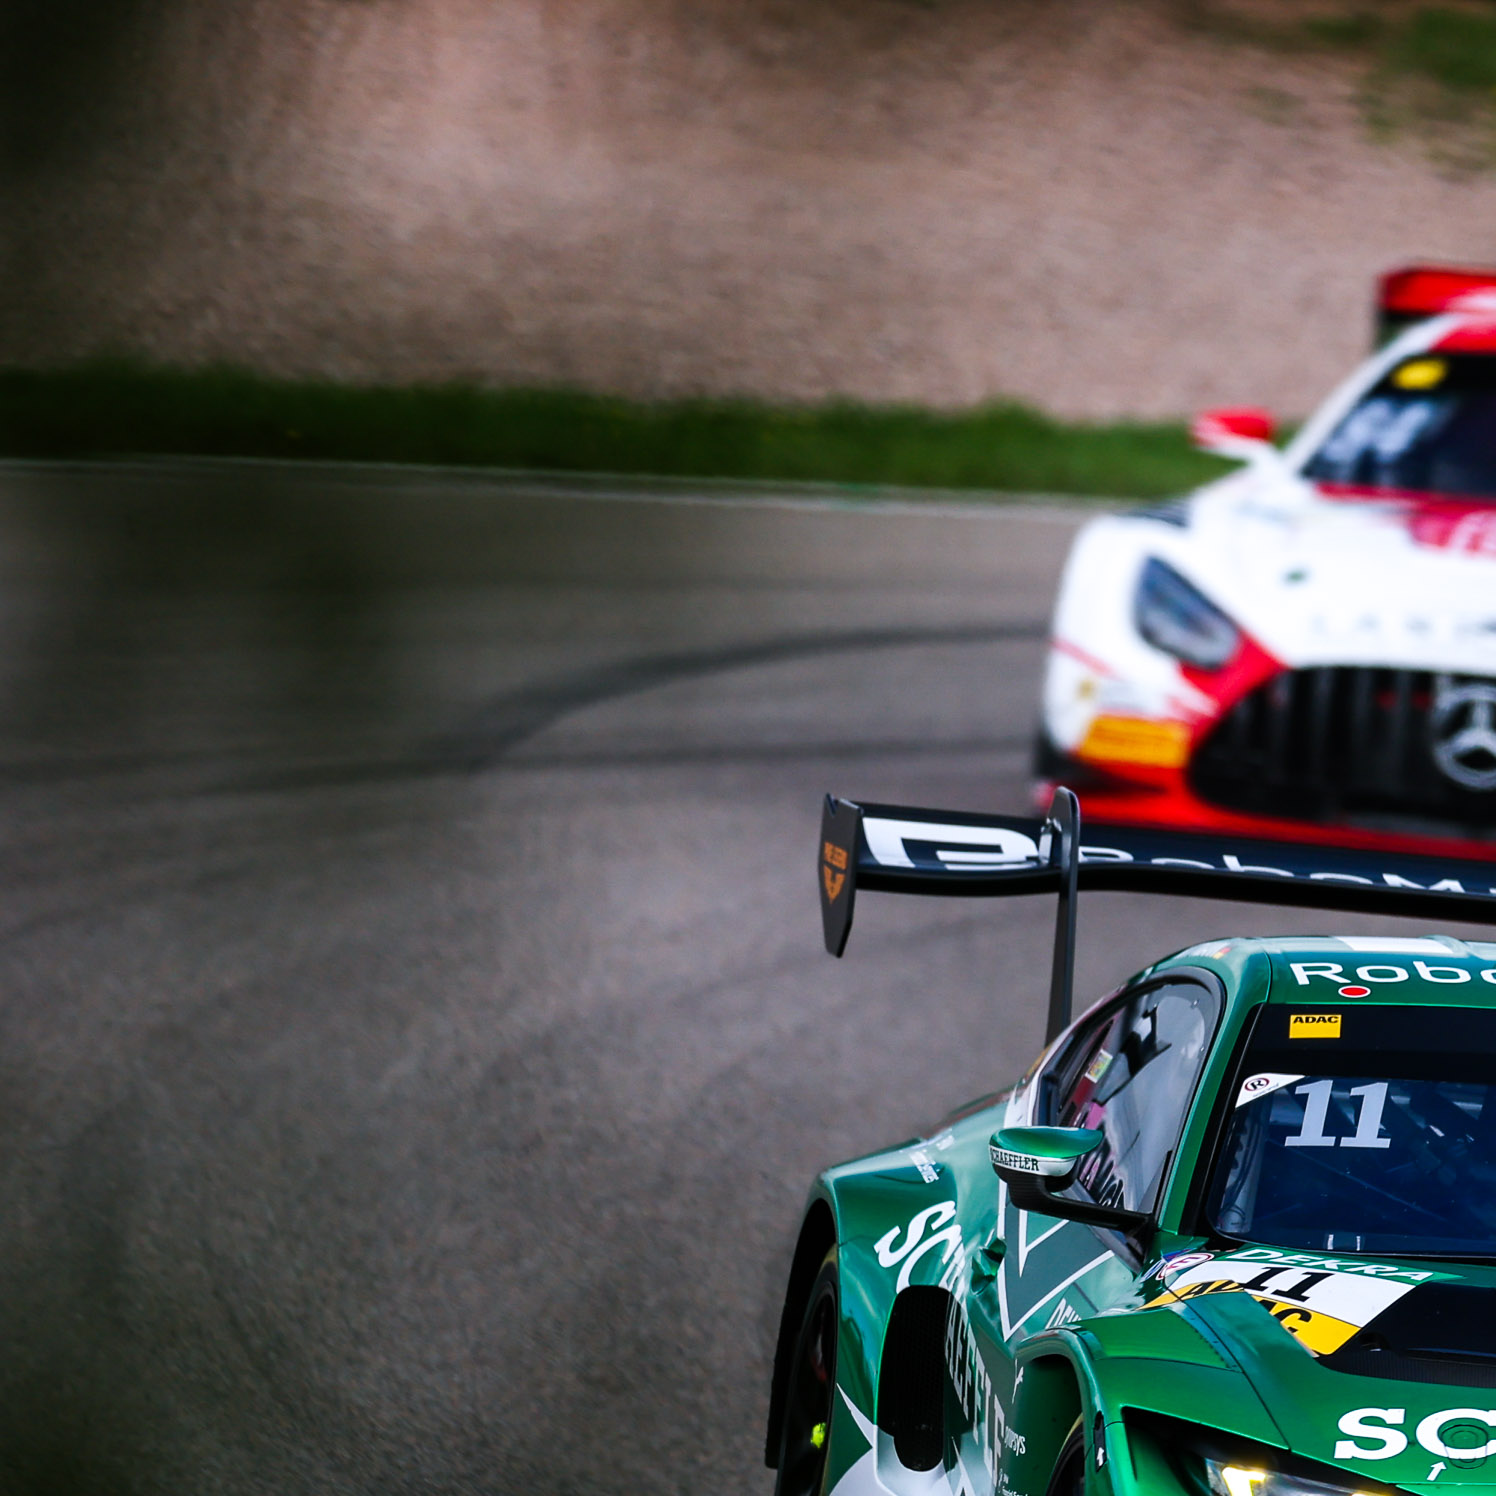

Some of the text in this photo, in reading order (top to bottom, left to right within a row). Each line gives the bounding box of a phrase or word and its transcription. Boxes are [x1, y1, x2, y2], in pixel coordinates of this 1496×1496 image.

[1292, 1016, 1340, 1024] ADAC
[1284, 1079, 1392, 1149] 11
[1225, 1248, 1434, 1282] DEKRA
[1239, 1266, 1335, 1303] 11
